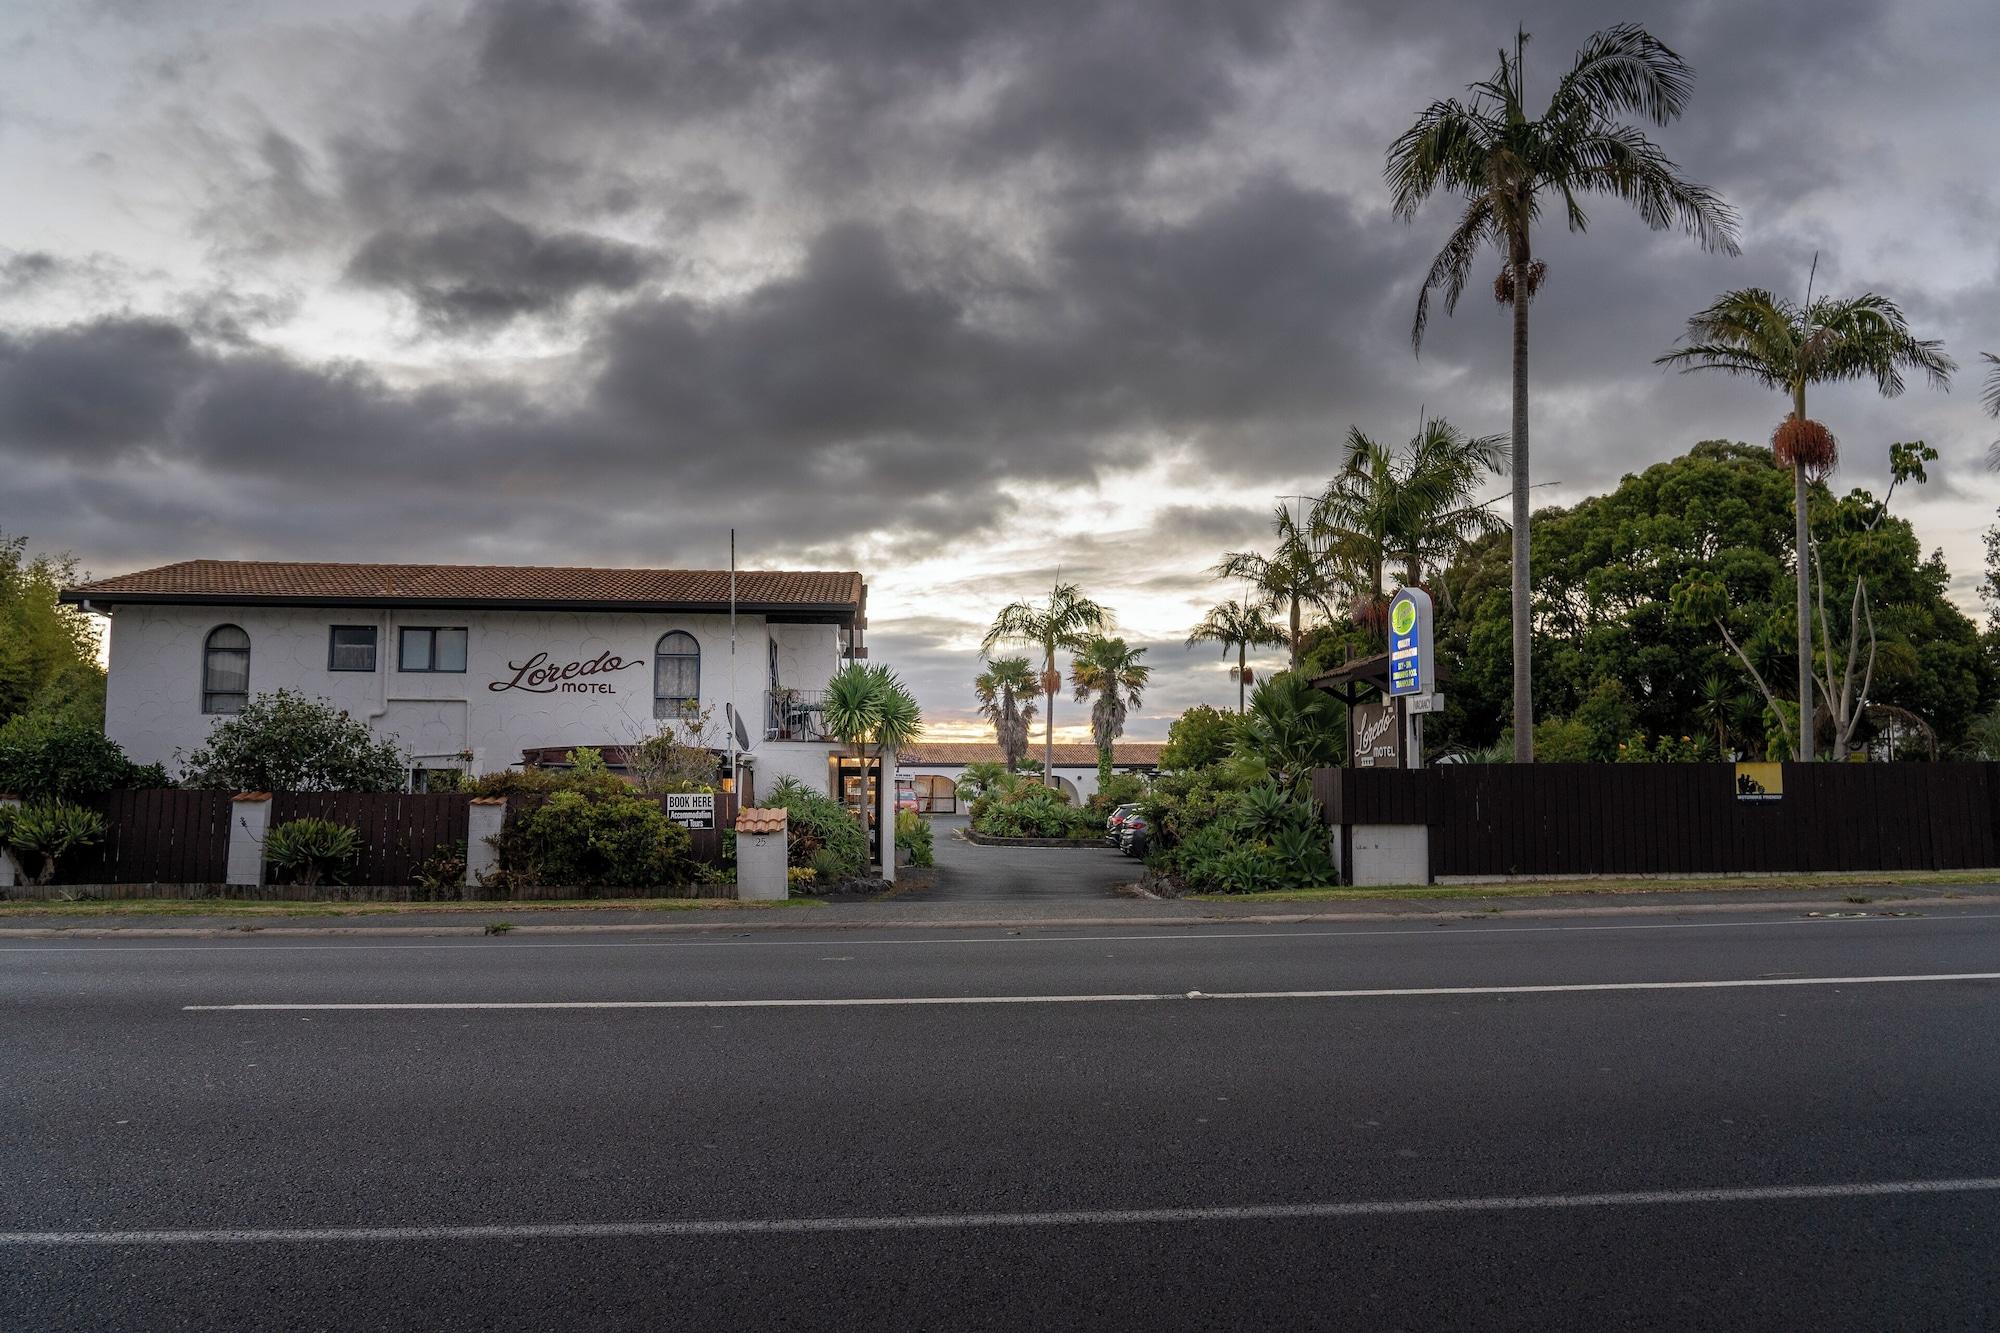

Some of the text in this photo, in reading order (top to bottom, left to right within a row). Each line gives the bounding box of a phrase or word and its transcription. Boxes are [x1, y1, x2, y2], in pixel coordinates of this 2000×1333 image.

[488, 650, 645, 694] Loredo
[561, 682, 616, 694] MOTEL
[1355, 709, 1396, 757] Loredo
[1373, 745, 1395, 758] MOTEL
[669, 796, 712, 808] BOOK HERE
[670, 810, 712, 819] Accommodation
[689, 819, 704, 828] Tours
[755, 837, 767, 847] 25
